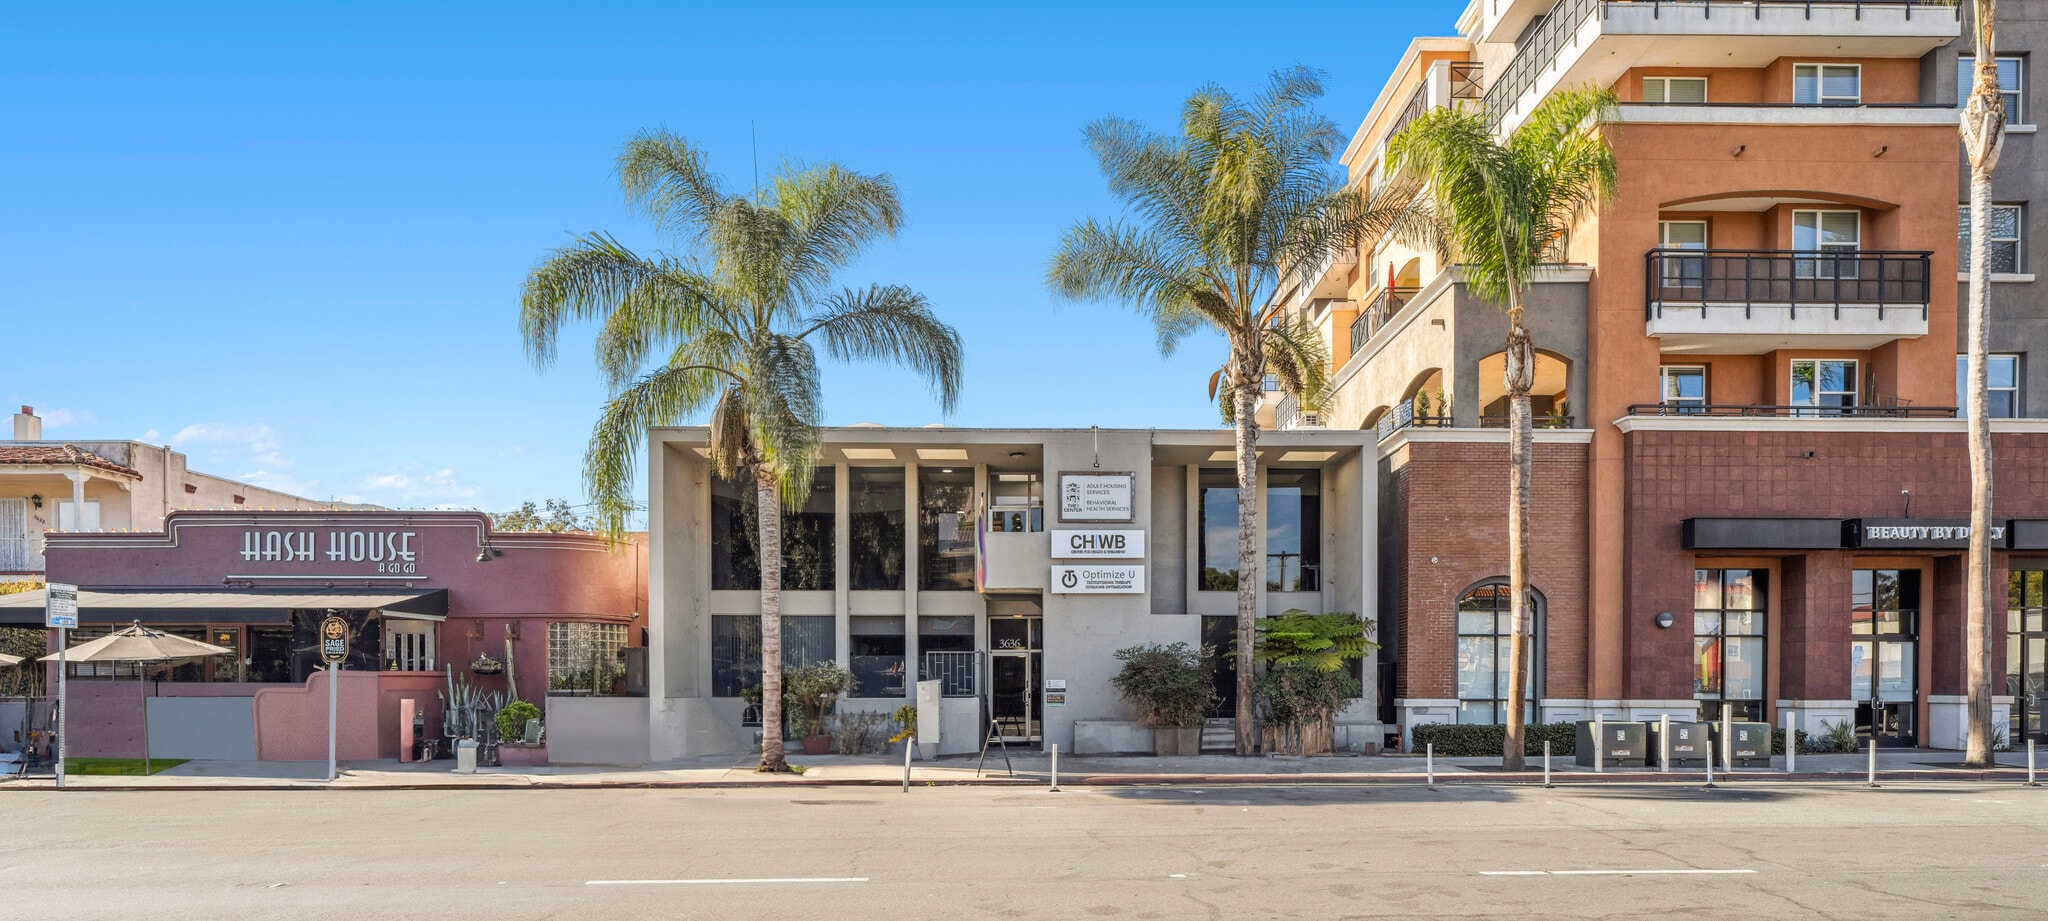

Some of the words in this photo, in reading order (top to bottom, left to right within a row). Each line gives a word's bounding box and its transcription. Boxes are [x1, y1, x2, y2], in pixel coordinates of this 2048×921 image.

[1866, 526, 1929, 539] BEAUTY
[1930, 526, 1953, 539] BY
[240, 531, 315, 561] HASH
[325, 531, 416, 562] HOUSE
[378, 563, 385, 573] A
[388, 563, 400, 573] GO
[404, 563, 416, 573] GO
[1083, 570, 1125, 580] Optimize
[1129, 570, 1135, 578] U
[999, 639, 1021, 648] 3636
